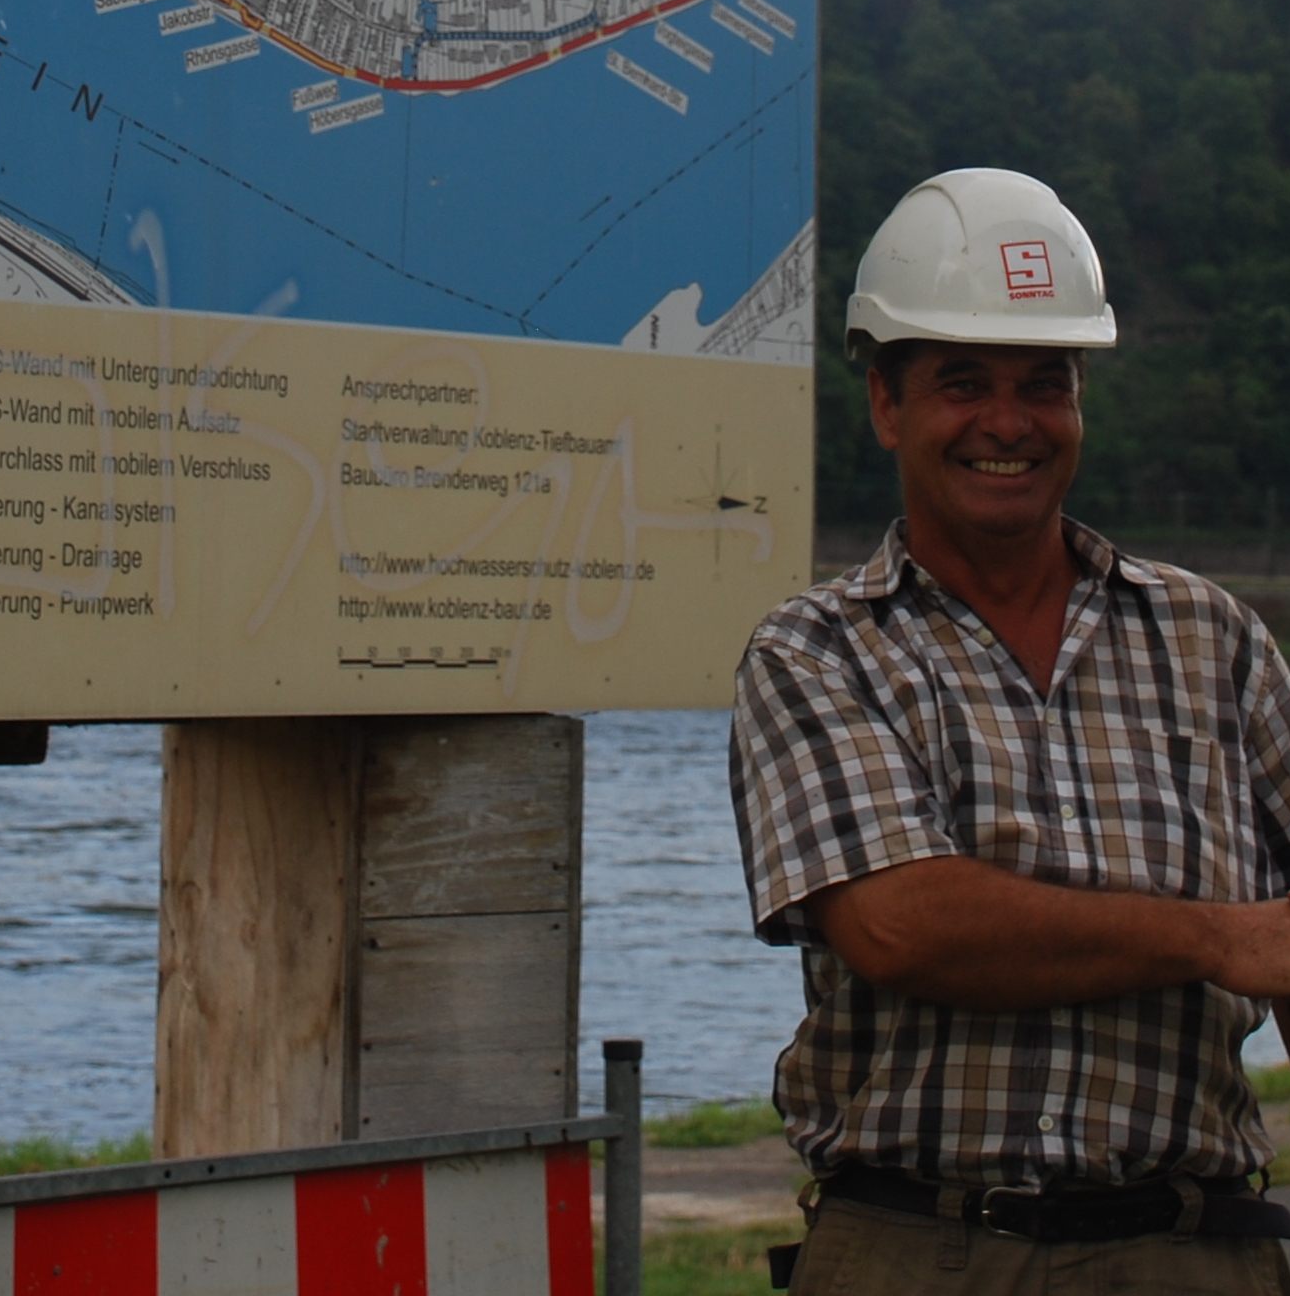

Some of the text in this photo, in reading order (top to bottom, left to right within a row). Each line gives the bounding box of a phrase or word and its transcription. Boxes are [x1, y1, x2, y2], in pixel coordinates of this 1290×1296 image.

[1009, 289, 1056, 301] SONNTAG
[69, 355, 97, 380] mit
[101, 356, 289, 398] Untergrundabdichtung
[341, 374, 479, 406] Ansprechpartner:
[67, 402, 95, 427] mit
[100, 405, 174, 431] mobilem
[177, 406, 242, 435] Aufsatz
[341, 418, 470, 452] Stadtverwaltung
[69, 449, 97, 474] mit
[102, 452, 175, 477] mobilem
[179, 454, 272, 481] Verschluss
[413, 465, 510, 498] Brenderweg
[513, 470, 552, 494] 121a
[62, 496, 176, 527] Kanalsystem
[61, 542, 143, 574] Drainage
[59, 590, 155, 620] Pumpwerk
[338, 594, 553, 622] http://www.koblenz-baut.de
